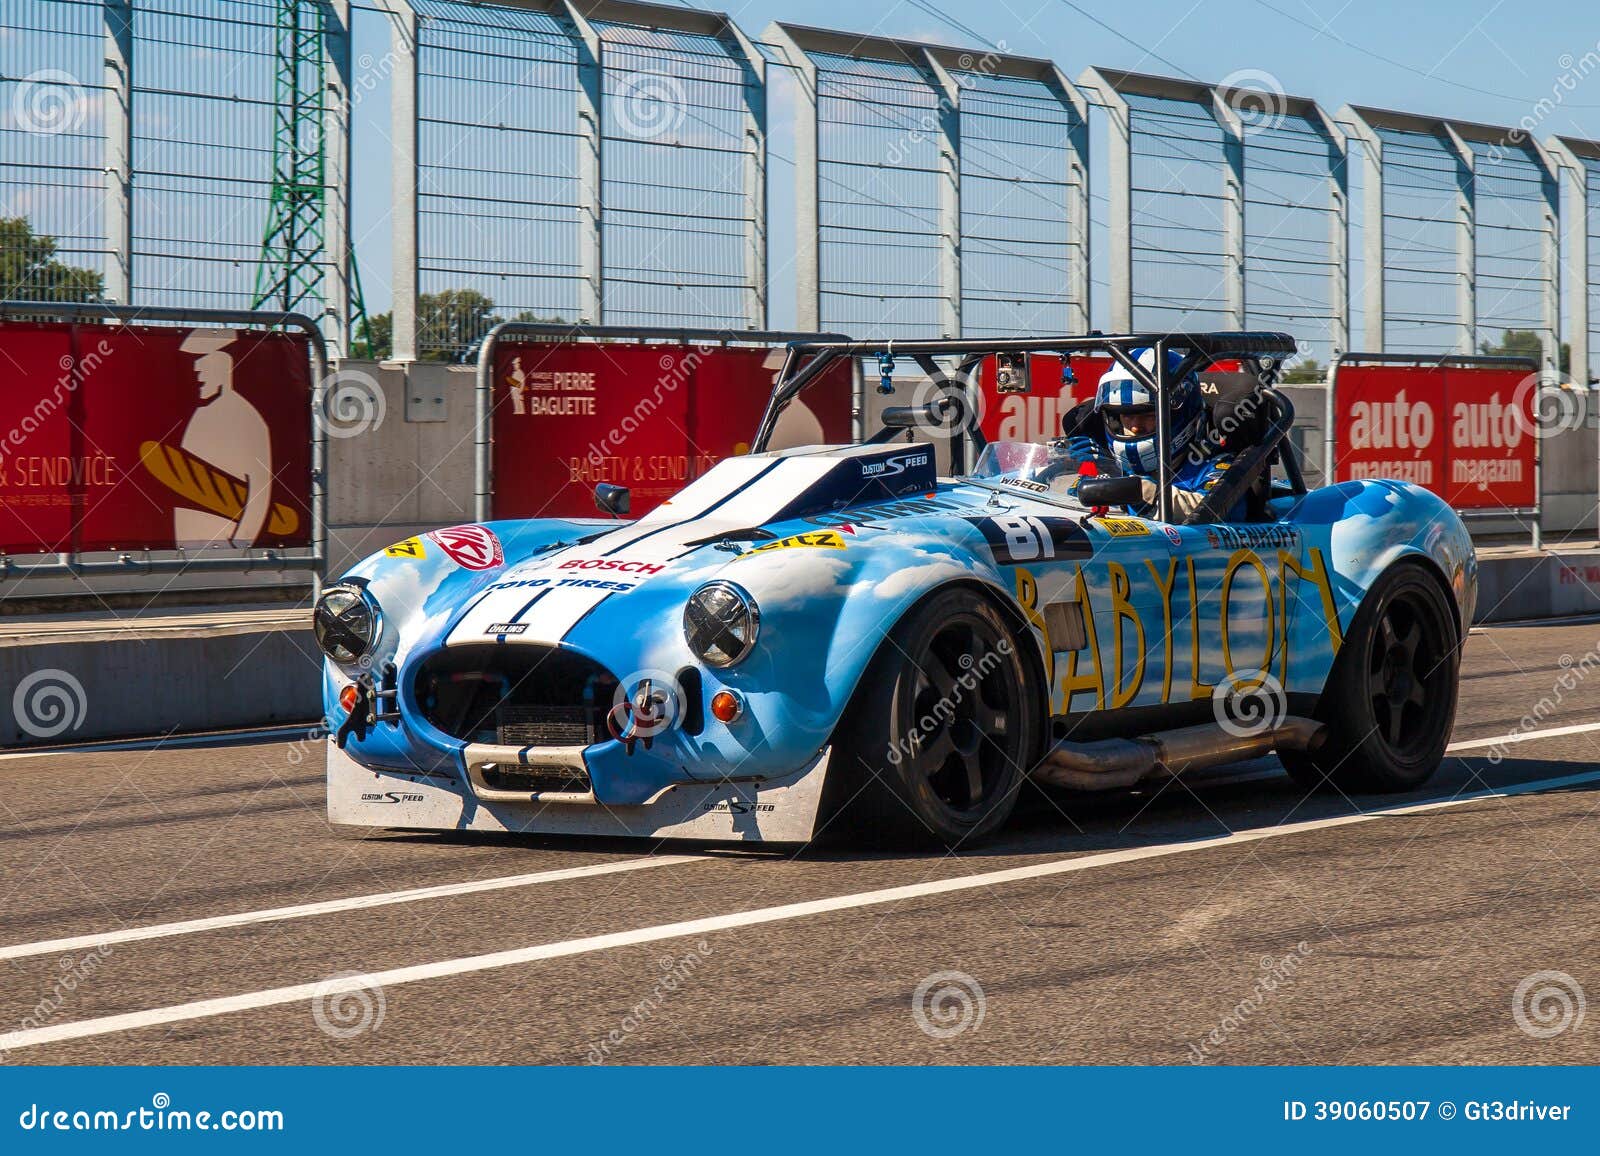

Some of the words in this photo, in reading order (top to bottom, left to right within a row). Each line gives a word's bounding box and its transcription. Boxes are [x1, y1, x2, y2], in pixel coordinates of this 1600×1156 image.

[553, 372, 596, 390] PIERRE
[531, 396, 596, 415] BAGUETTE
[998, 384, 1097, 445] aut
[1350, 388, 1434, 449] auto
[1453, 391, 1522, 448] auto
[569, 456, 629, 483] BAGETY
[632, 456, 645, 482] &
[1452, 446, 1522, 492] magazín
[1000, 476, 1049, 493] WISECO
[992, 516, 1055, 560] 81
[557, 559, 667, 575] BOSCH
[485, 578, 552, 592] TOYO
[556, 578, 636, 592] TIRES
[1015, 548, 1344, 718] BABYLON
[361, 793, 384, 801] CUSTOM
[384, 792, 424, 804] SPEED
